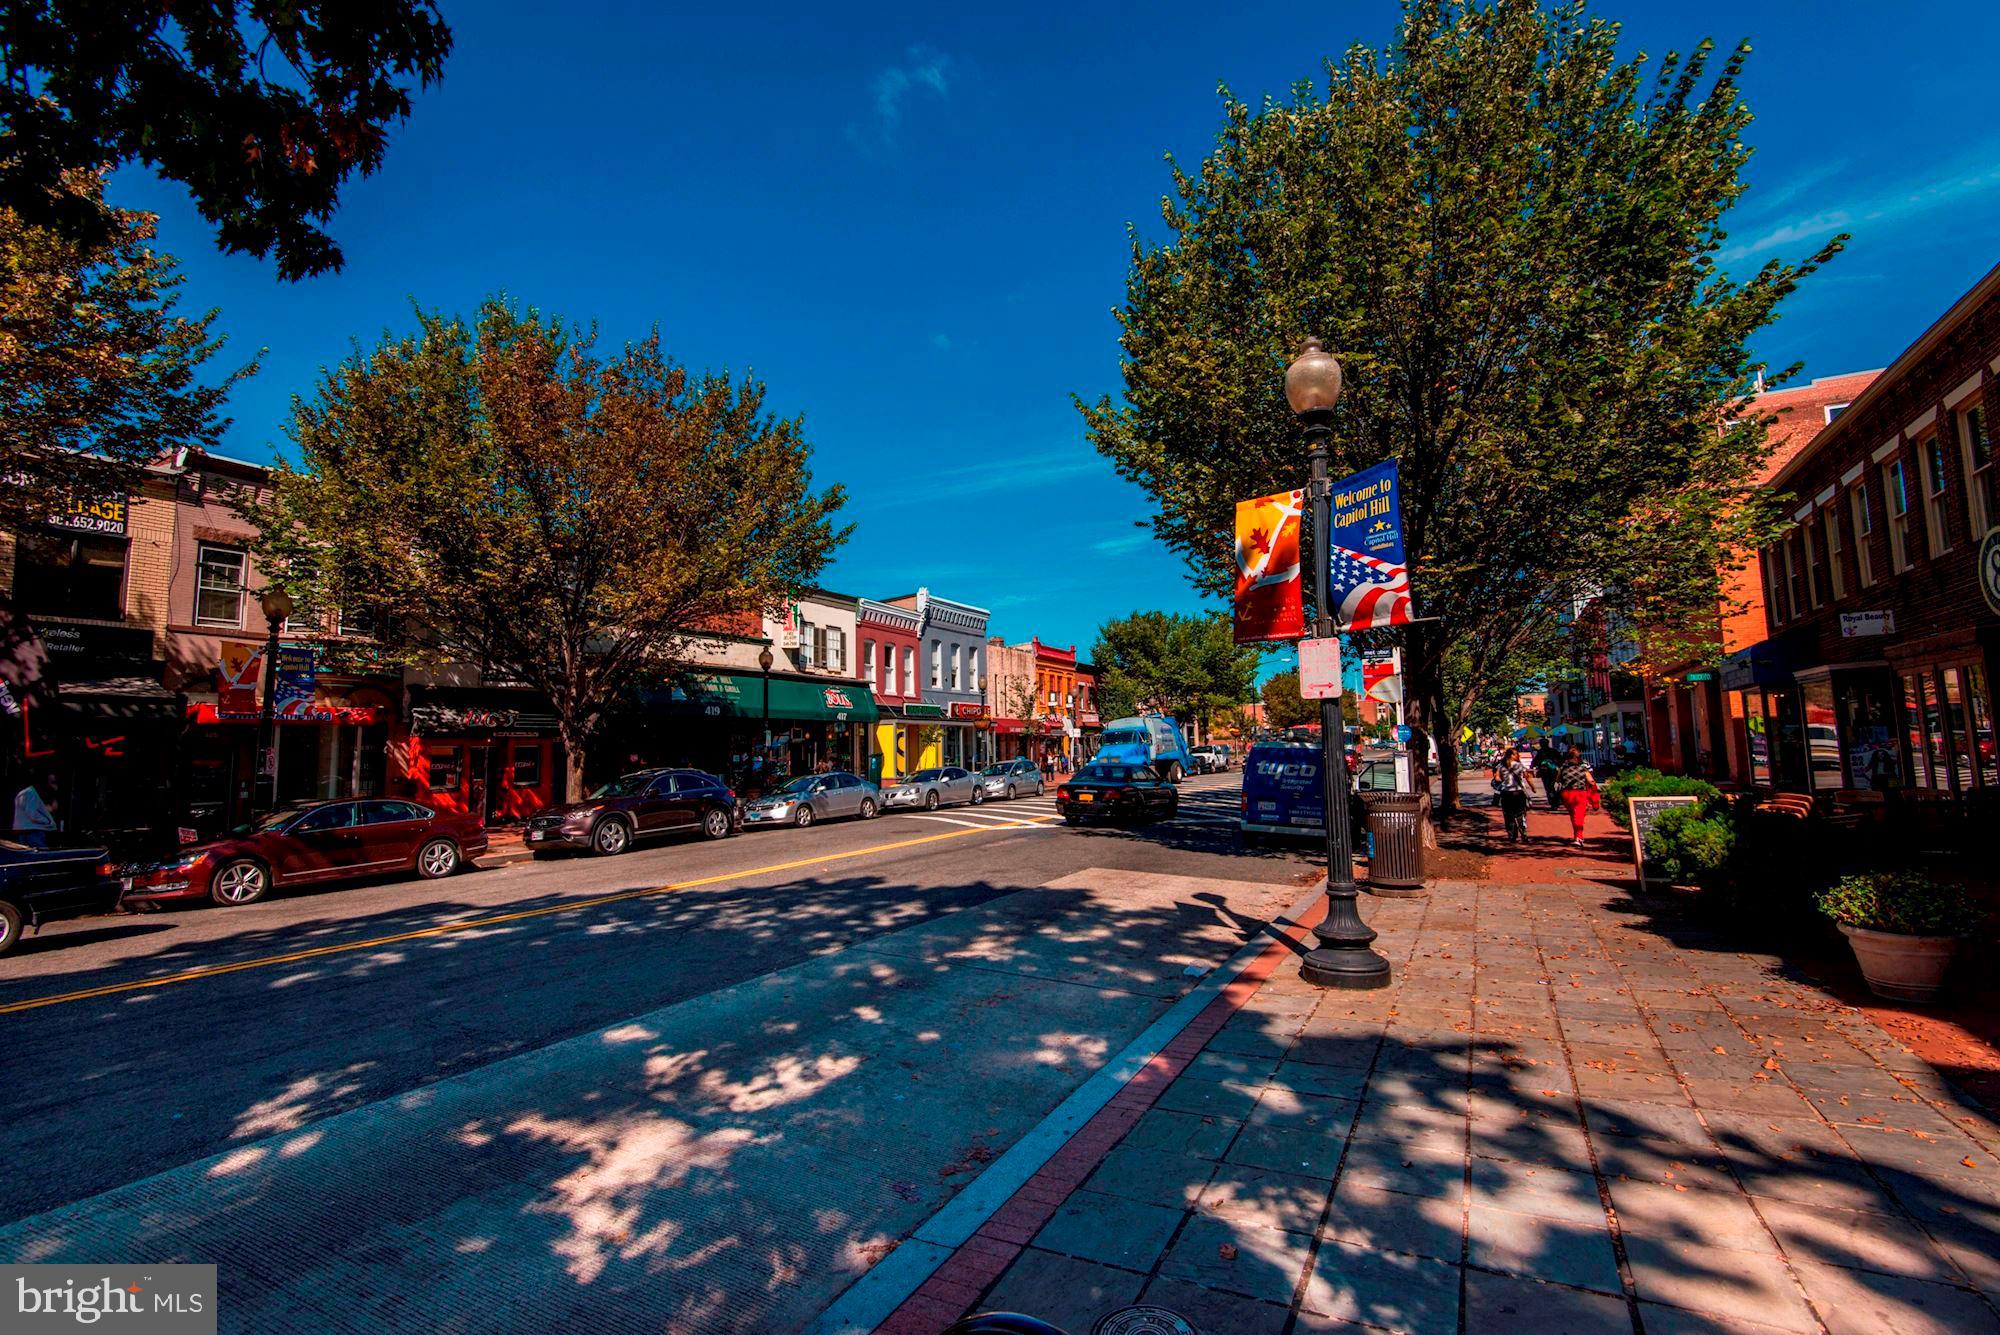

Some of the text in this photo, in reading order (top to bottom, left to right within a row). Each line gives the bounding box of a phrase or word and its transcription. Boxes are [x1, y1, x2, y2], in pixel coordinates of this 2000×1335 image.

[1335, 478, 1392, 510] Welcome to
[1334, 496, 1390, 529] Capitol Hill
[1843, 614, 1863, 623] Royal
[704, 705, 721, 717] 419
[836, 712, 848, 721] 417
[1256, 759, 1317, 780] tyco
